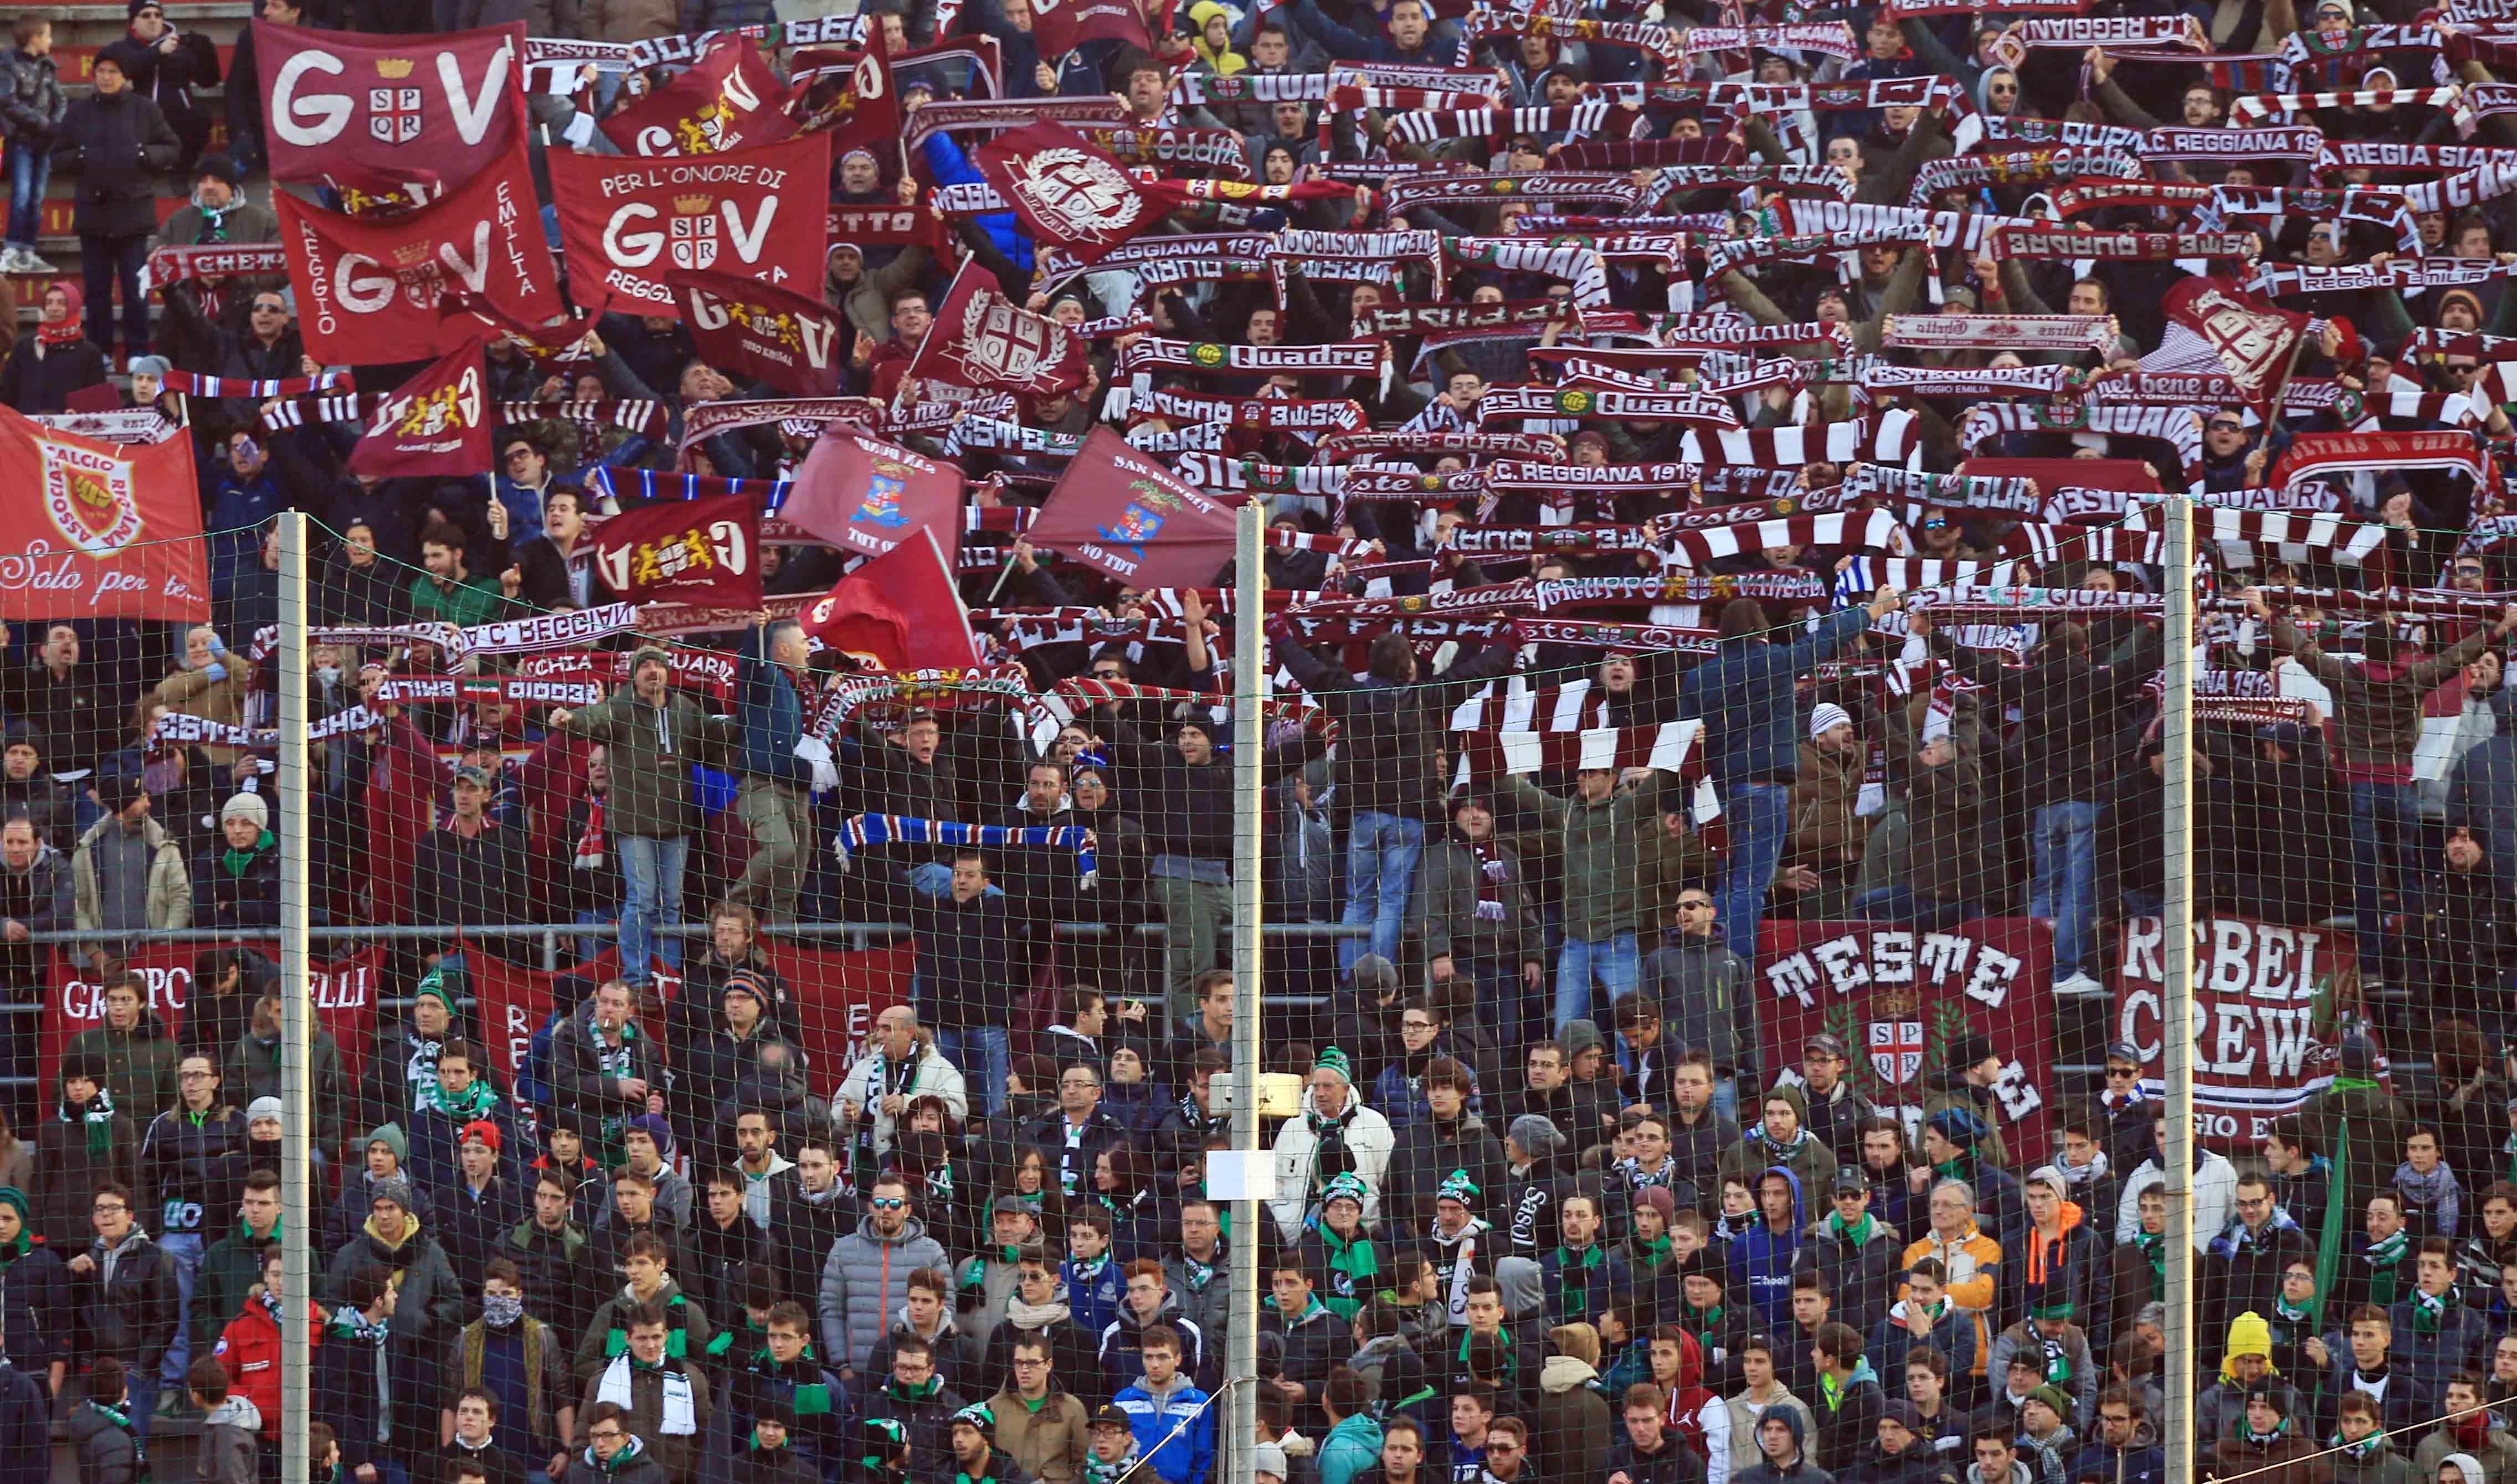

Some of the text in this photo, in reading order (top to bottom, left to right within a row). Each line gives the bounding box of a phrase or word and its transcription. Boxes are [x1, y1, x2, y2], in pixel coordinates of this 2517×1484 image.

[1602, 21, 1675, 58] VANDE
[2023, 18, 2146, 40] REGGIAN
[271, 47, 508, 147] G V
[2174, 133, 2287, 152] REGGIANA
[2295, 133, 2318, 152] 19
[2340, 143, 2517, 167] REGIA SIAM
[600, 172, 643, 198] PER
[756, 169, 787, 190] DI
[2079, 184, 2206, 200] TESTE QUA
[603, 195, 778, 267] G V
[828, 212, 915, 233] ETTO
[496, 181, 536, 297] EMILIA
[1102, 238, 1274, 261] EGGIANA 191
[1301, 233, 1369, 256] NOSTRO
[1596, 235, 1672, 253] Libe
[2007, 233, 2252, 256] ESTE QUADRE
[195, 253, 287, 273] GHETT
[334, 253, 397, 313] G
[439, 220, 491, 293] V
[299, 219, 336, 335] REGGIO
[605, 269, 676, 305] REGGI
[2304, 270, 2487, 290] REGGIO EMILIA
[1230, 344, 1374, 369] Quadre
[1862, 364, 2065, 391] ESTEQUADRE
[1914, 385, 1991, 394] REGGIO EMILIA
[2097, 374, 2134, 393] nel
[2139, 373, 2202, 395] bene
[962, 391, 1015, 415] male
[1481, 387, 1737, 424] este Quadre
[1124, 421, 1225, 454] ADRE
[1329, 434, 1568, 463] TESTE QUADRE
[48, 445, 115, 472] ALCIO
[1113, 455, 1149, 475] SAN
[1350, 472, 1413, 494] ste
[1521, 463, 1643, 482] REGGIANA
[2206, 485, 2332, 509] QUADR
[1655, 505, 1767, 532] Teste
[1447, 527, 1533, 551] QUA
[1078, 542, 1138, 576] NO TDT
[0, 539, 84, 591] Solo
[89, 571, 149, 606] per
[1430, 580, 1534, 609] Quadr
[1535, 577, 1662, 611] GRUPPO
[1526, 623, 1578, 638] ste
[1641, 627, 1719, 650] Qua
[2232, 671, 2273, 697] 191
[1765, 931, 2021, 1009] TESTE
[64, 967, 192, 1020] GRPPO
